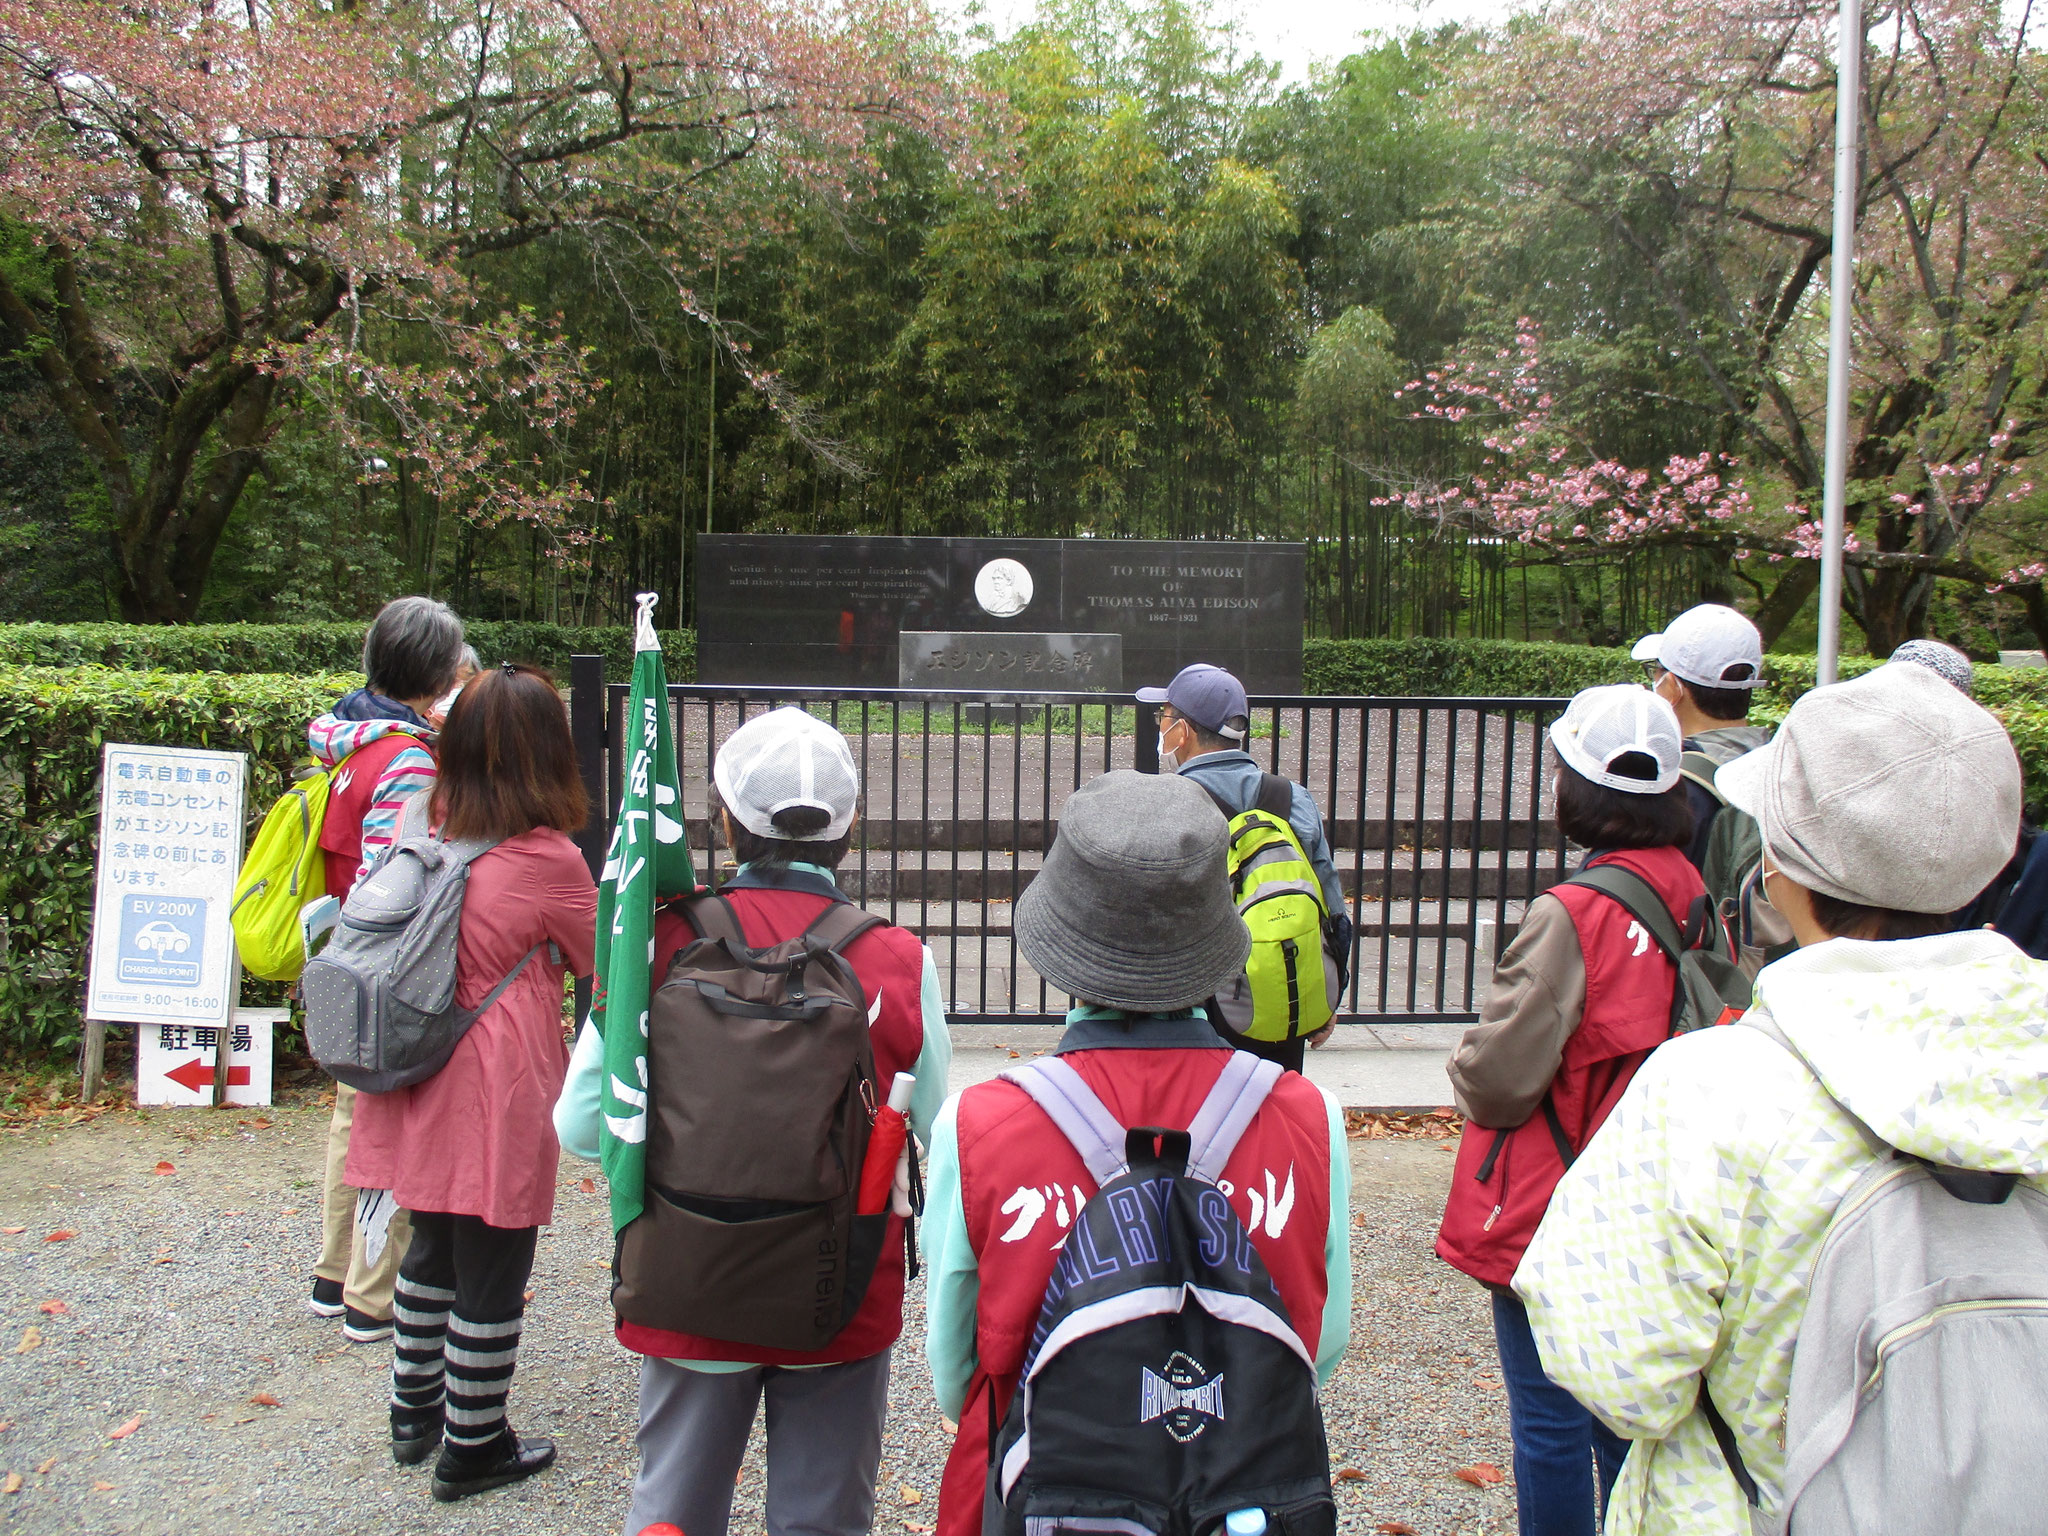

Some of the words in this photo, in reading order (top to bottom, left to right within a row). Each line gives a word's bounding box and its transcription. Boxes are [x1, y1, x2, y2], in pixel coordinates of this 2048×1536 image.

[1110, 565, 1133, 577] TO
[1140, 566, 1171, 577] THE
[1177, 566, 1244, 578] MEMORY
[729, 577, 749, 586] and
[1162, 581, 1184, 593] OF
[1087, 595, 1154, 608] THOMAS
[1202, 597, 1259, 609] EDISON
[927, 649, 1093, 674] エジソン記念碑
[117, 763, 231, 784] 電気自動車の
[116, 789, 229, 811] 充電コンセント
[115, 816, 229, 838] がエジソン記
[113, 842, 226, 864] 念碑の前にあ
[113, 869, 166, 887] ります。
[133, 900, 155, 914] EV
[158, 902, 197, 917] 200V
[124, 965, 168, 975] CHARGING
[169, 967, 195, 977] POINT
